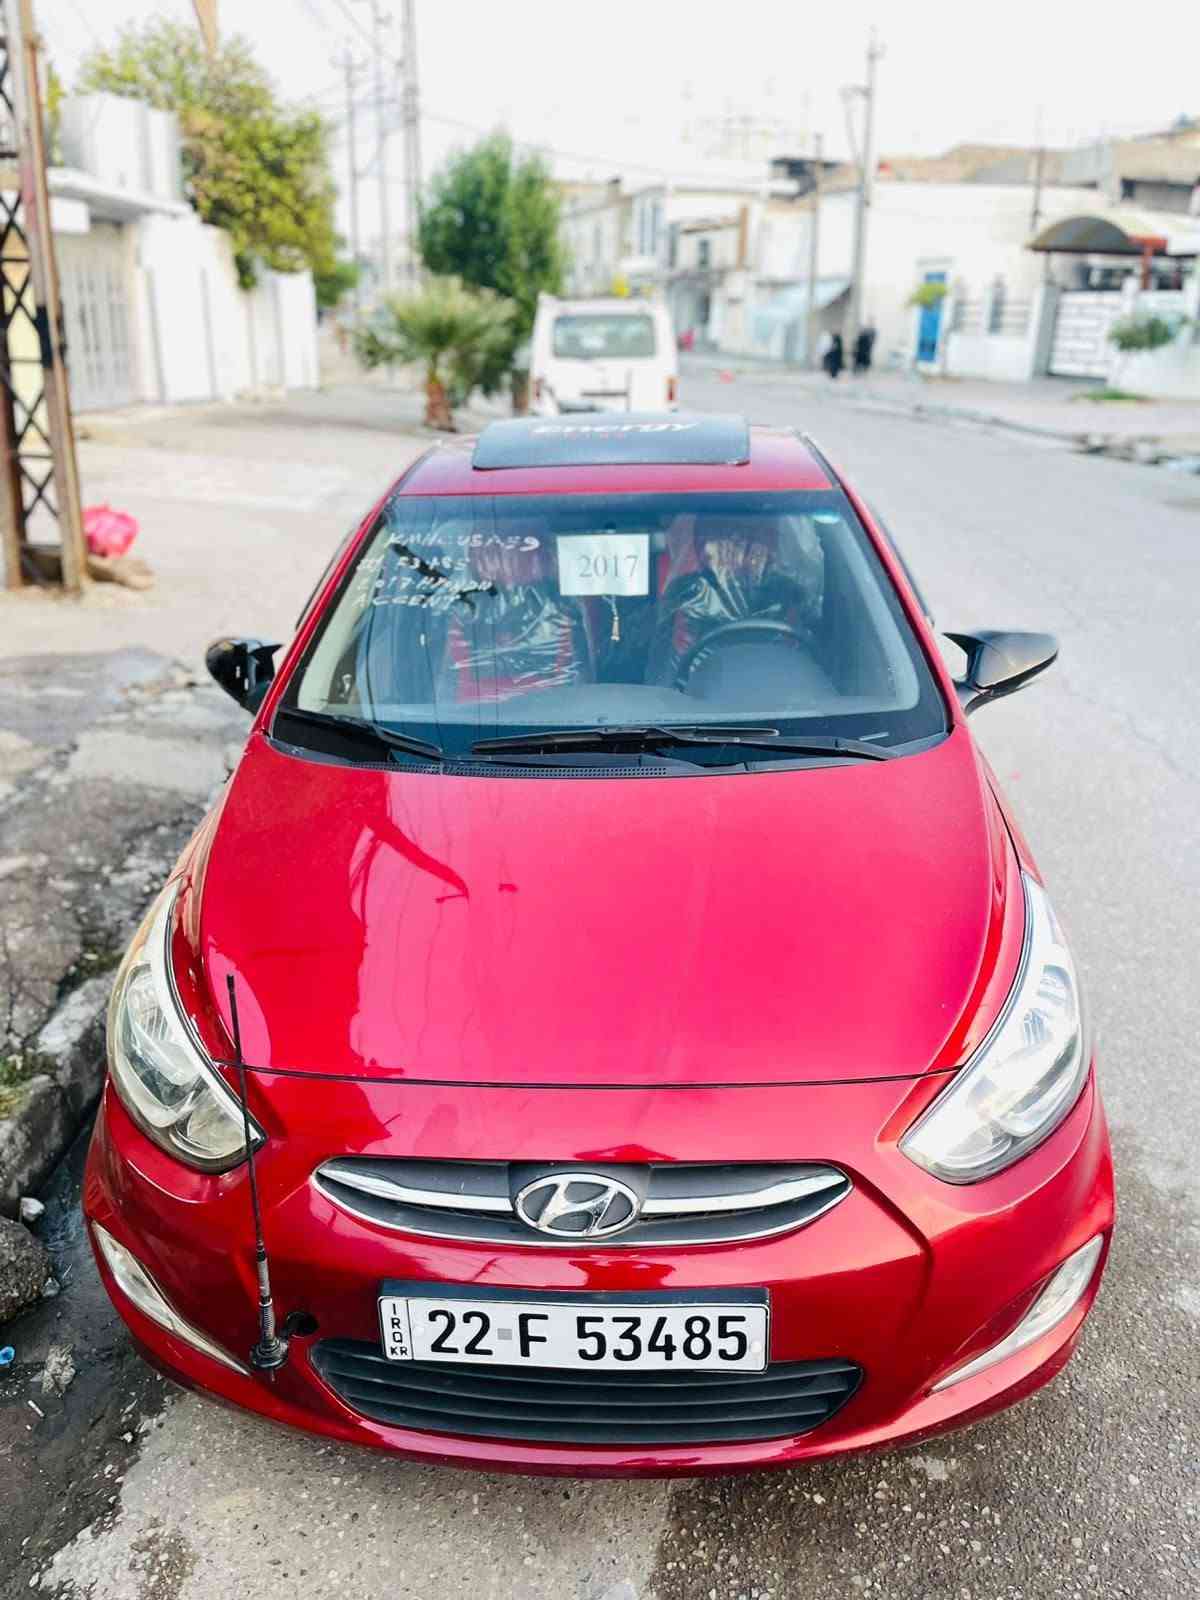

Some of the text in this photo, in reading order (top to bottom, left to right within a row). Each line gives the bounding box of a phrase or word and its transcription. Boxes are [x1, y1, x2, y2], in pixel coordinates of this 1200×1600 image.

[577, 554, 638, 578] 2017
[428, 1309, 748, 1362] 22 F 53485
[390, 1346, 408, 1356] KR
